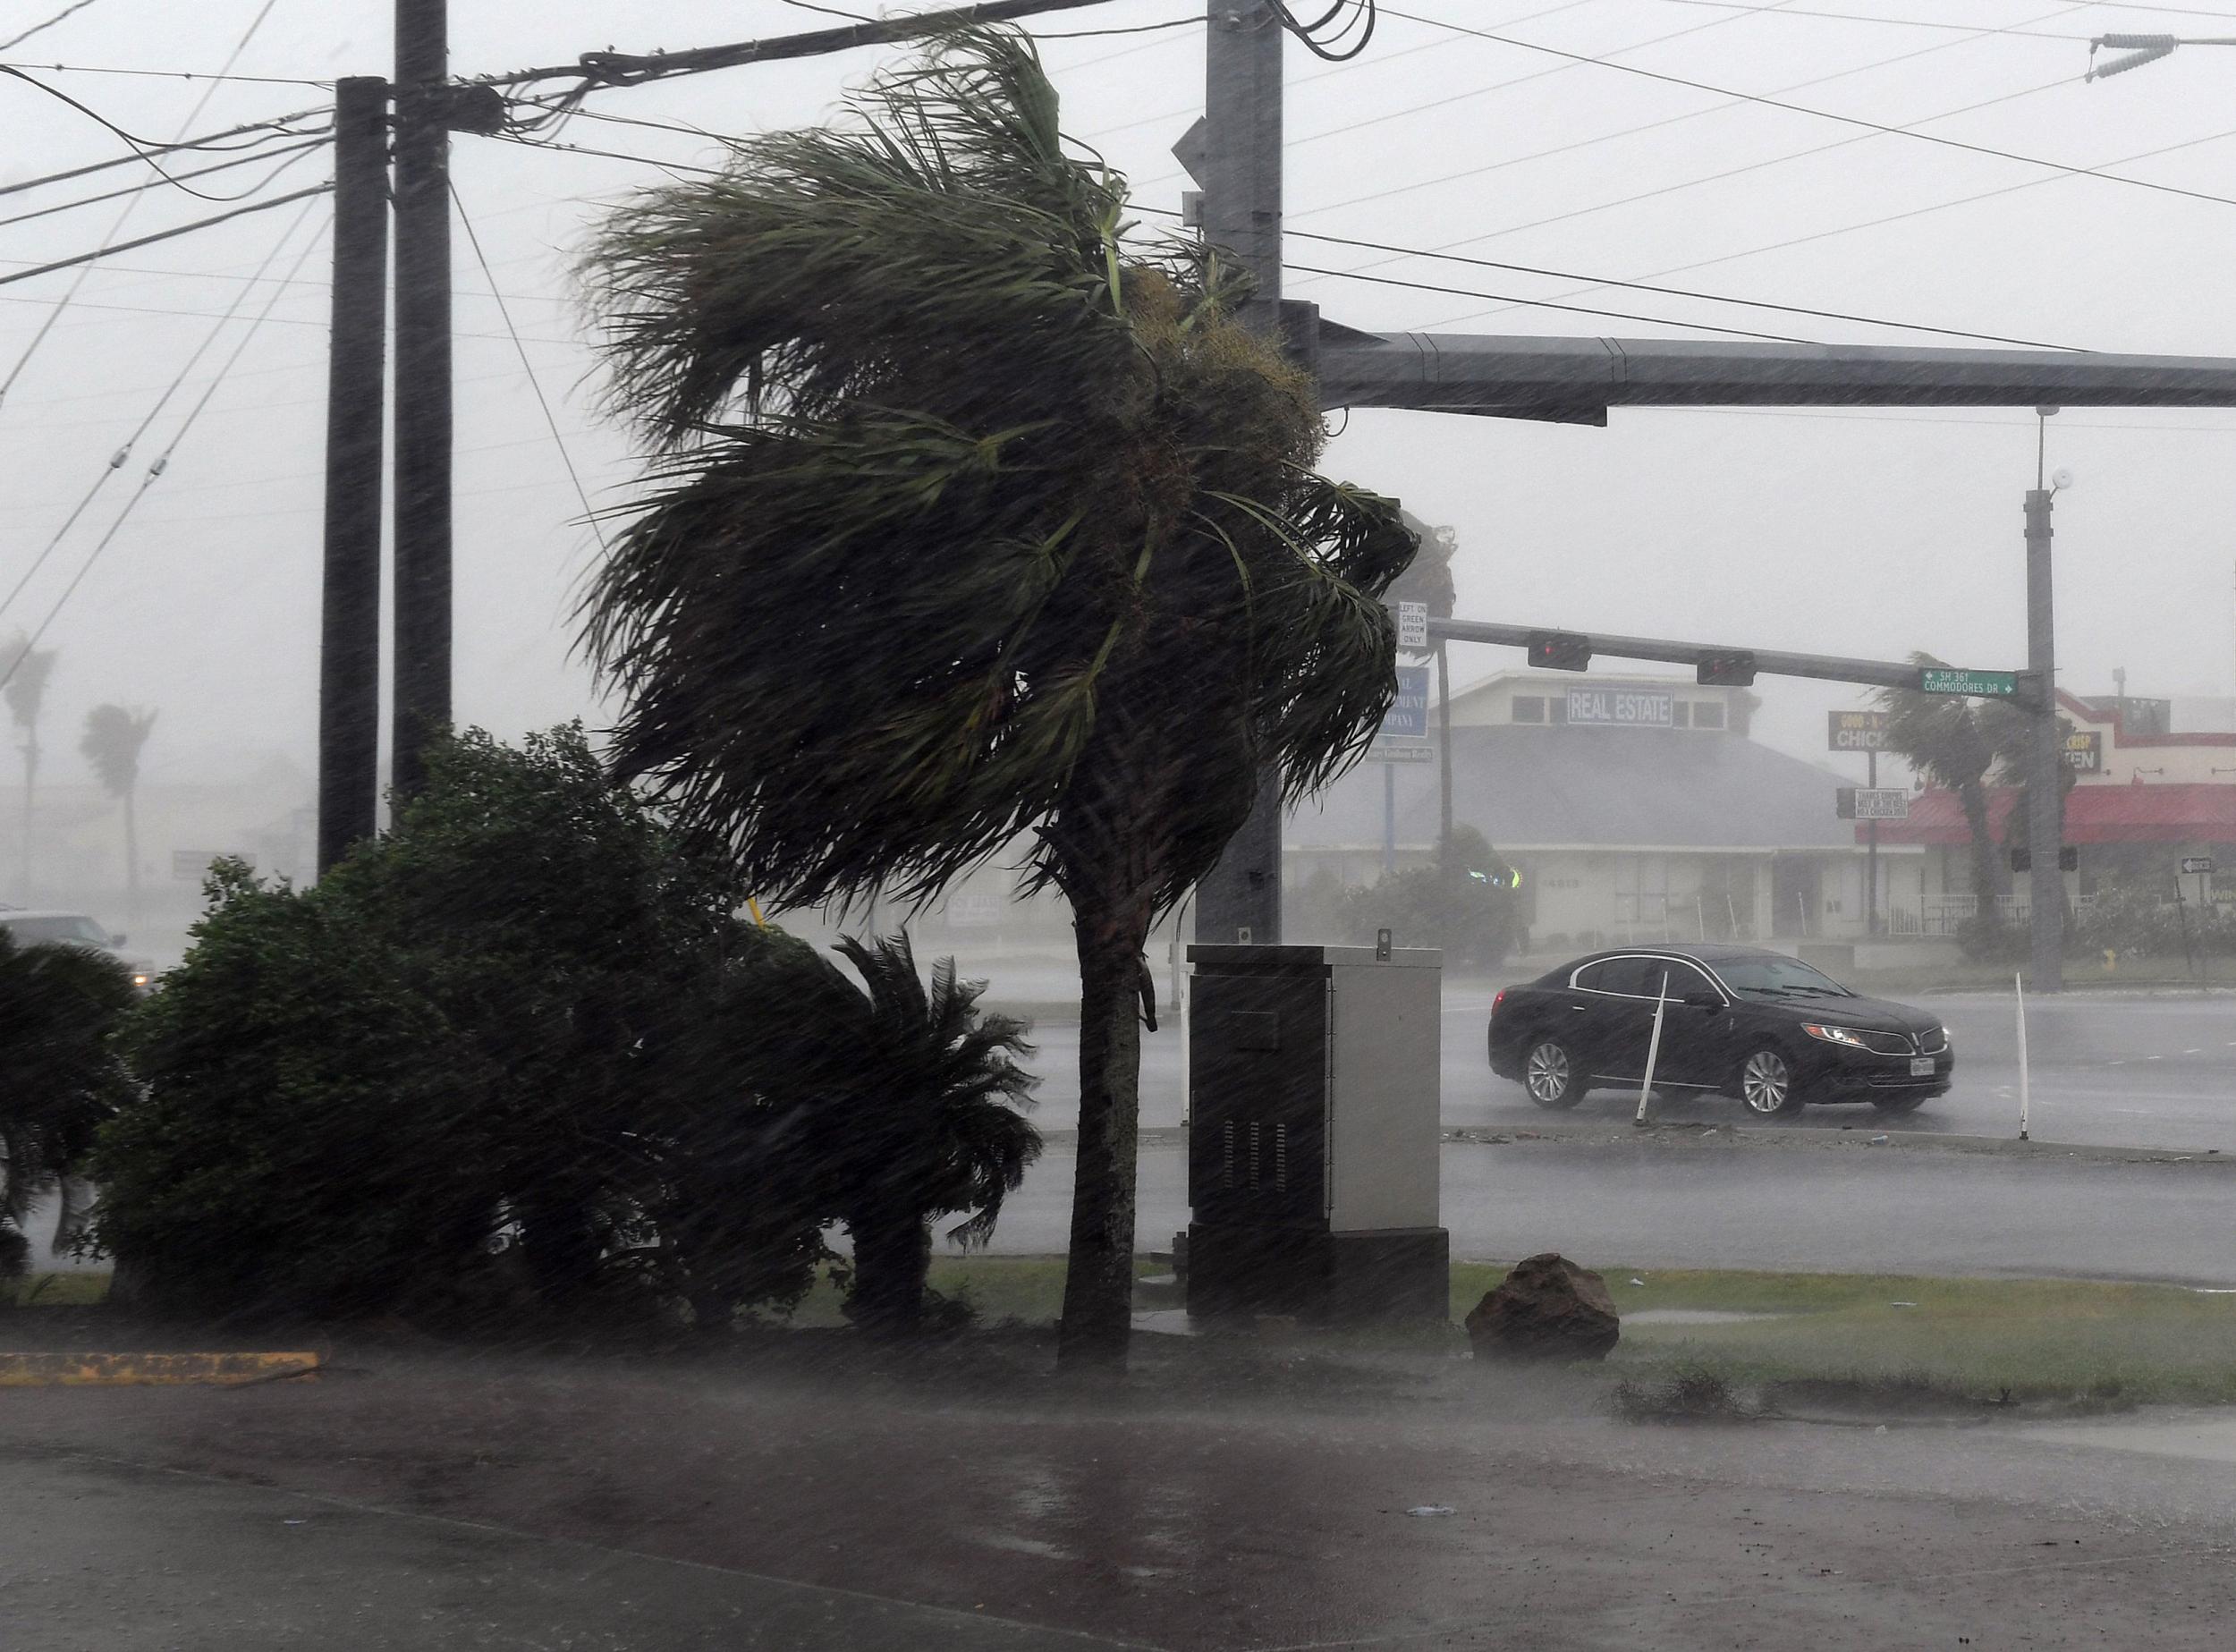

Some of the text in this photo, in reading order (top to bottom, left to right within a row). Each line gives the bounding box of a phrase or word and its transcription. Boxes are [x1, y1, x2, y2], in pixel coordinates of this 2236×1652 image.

[1401, 605, 1413, 613] LEFT
[1402, 614, 1424, 623] GREEN
[1402, 625, 1425, 633] ARROW
[1403, 635, 1422, 643] ONLY
[1940, 671, 1969, 682] SH 361
[1924, 681, 1998, 694] COMMODORES DR
[1571, 692, 1669, 721] REAL ESTATE
[1837, 730, 1889, 748] CHICK
